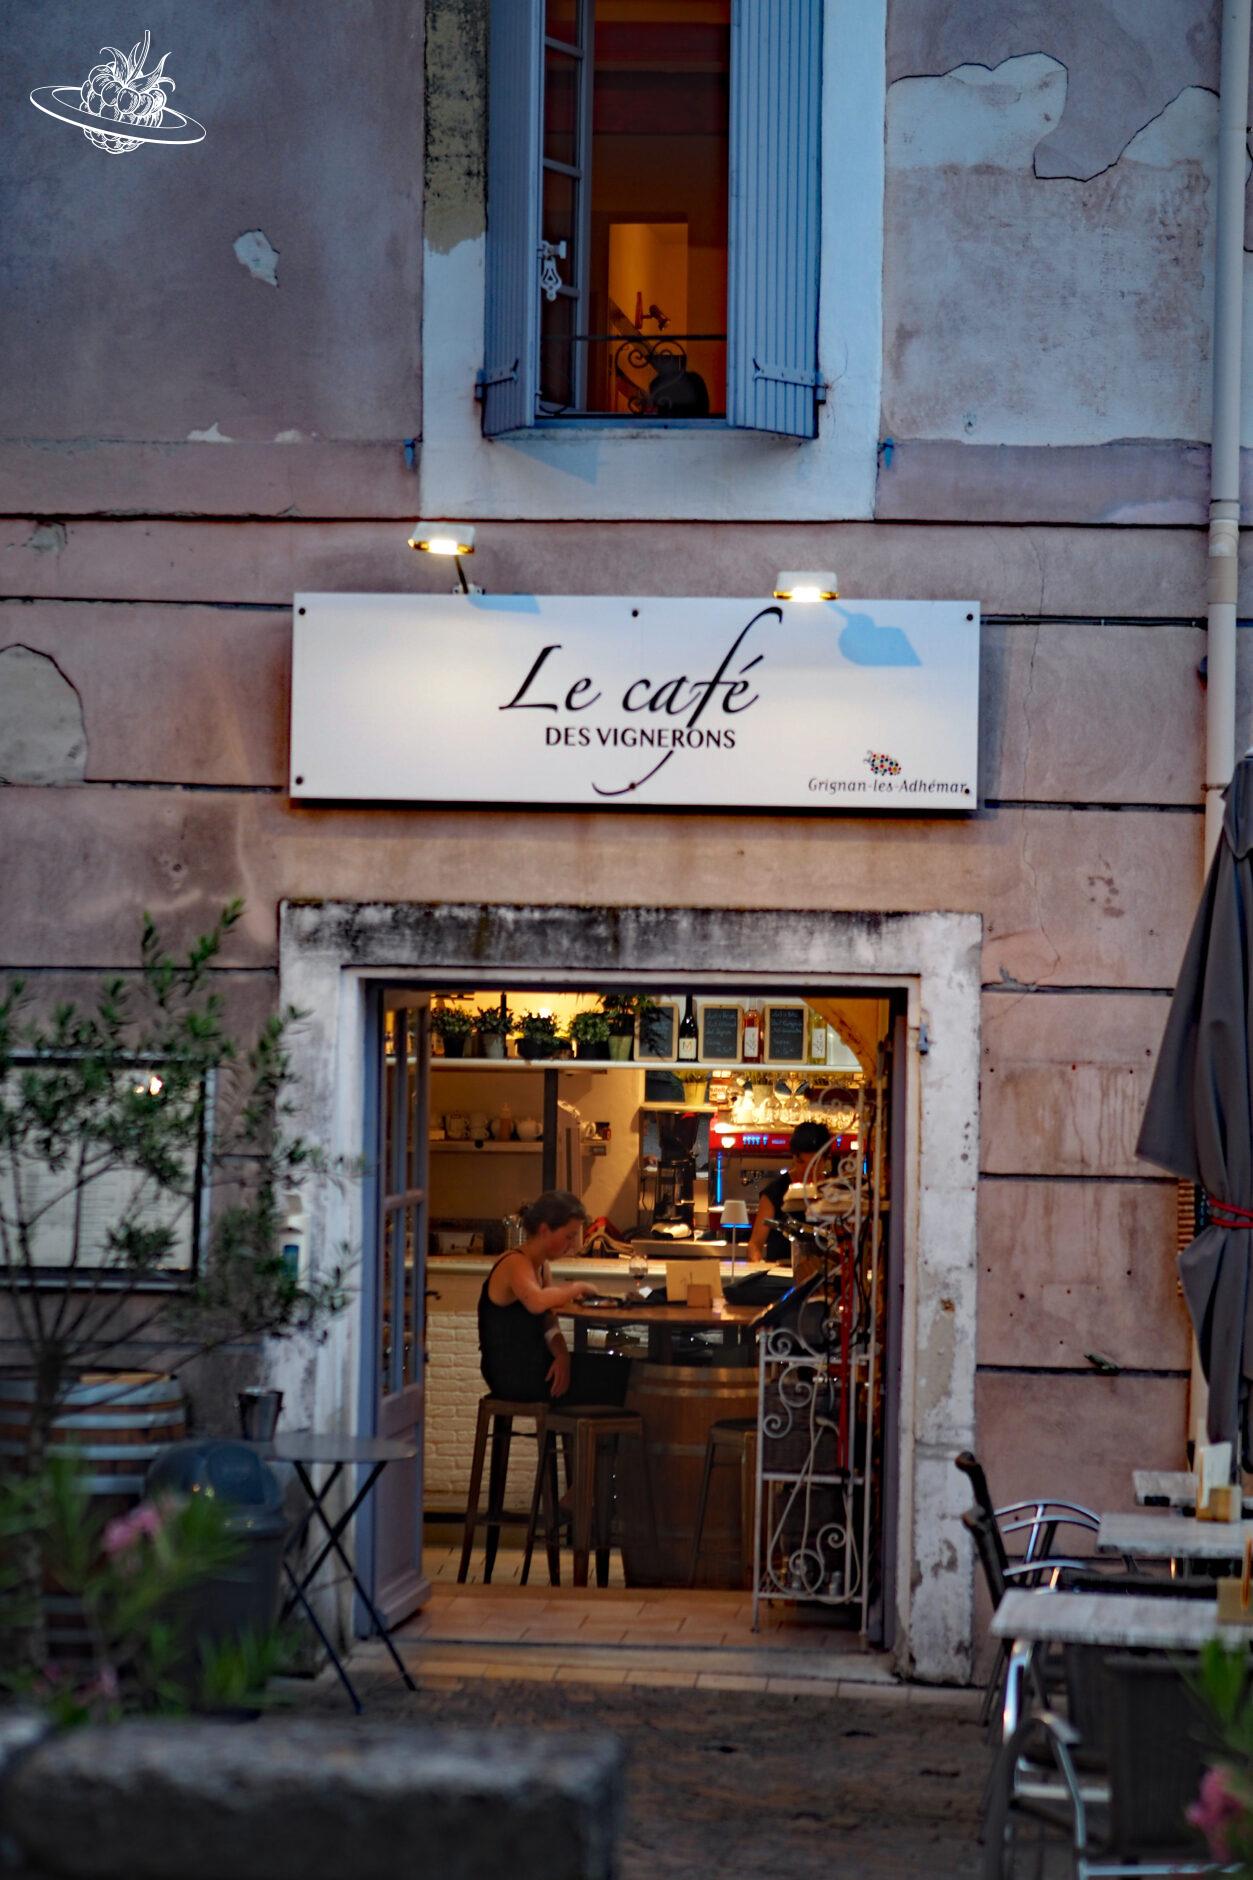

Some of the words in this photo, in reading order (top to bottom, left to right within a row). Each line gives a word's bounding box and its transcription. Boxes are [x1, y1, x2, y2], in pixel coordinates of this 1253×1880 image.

[499, 645, 602, 712] Le
[592, 606, 783, 796] café
[545, 726, 591, 747] DES
[597, 727, 736, 749] VIGNERONS
